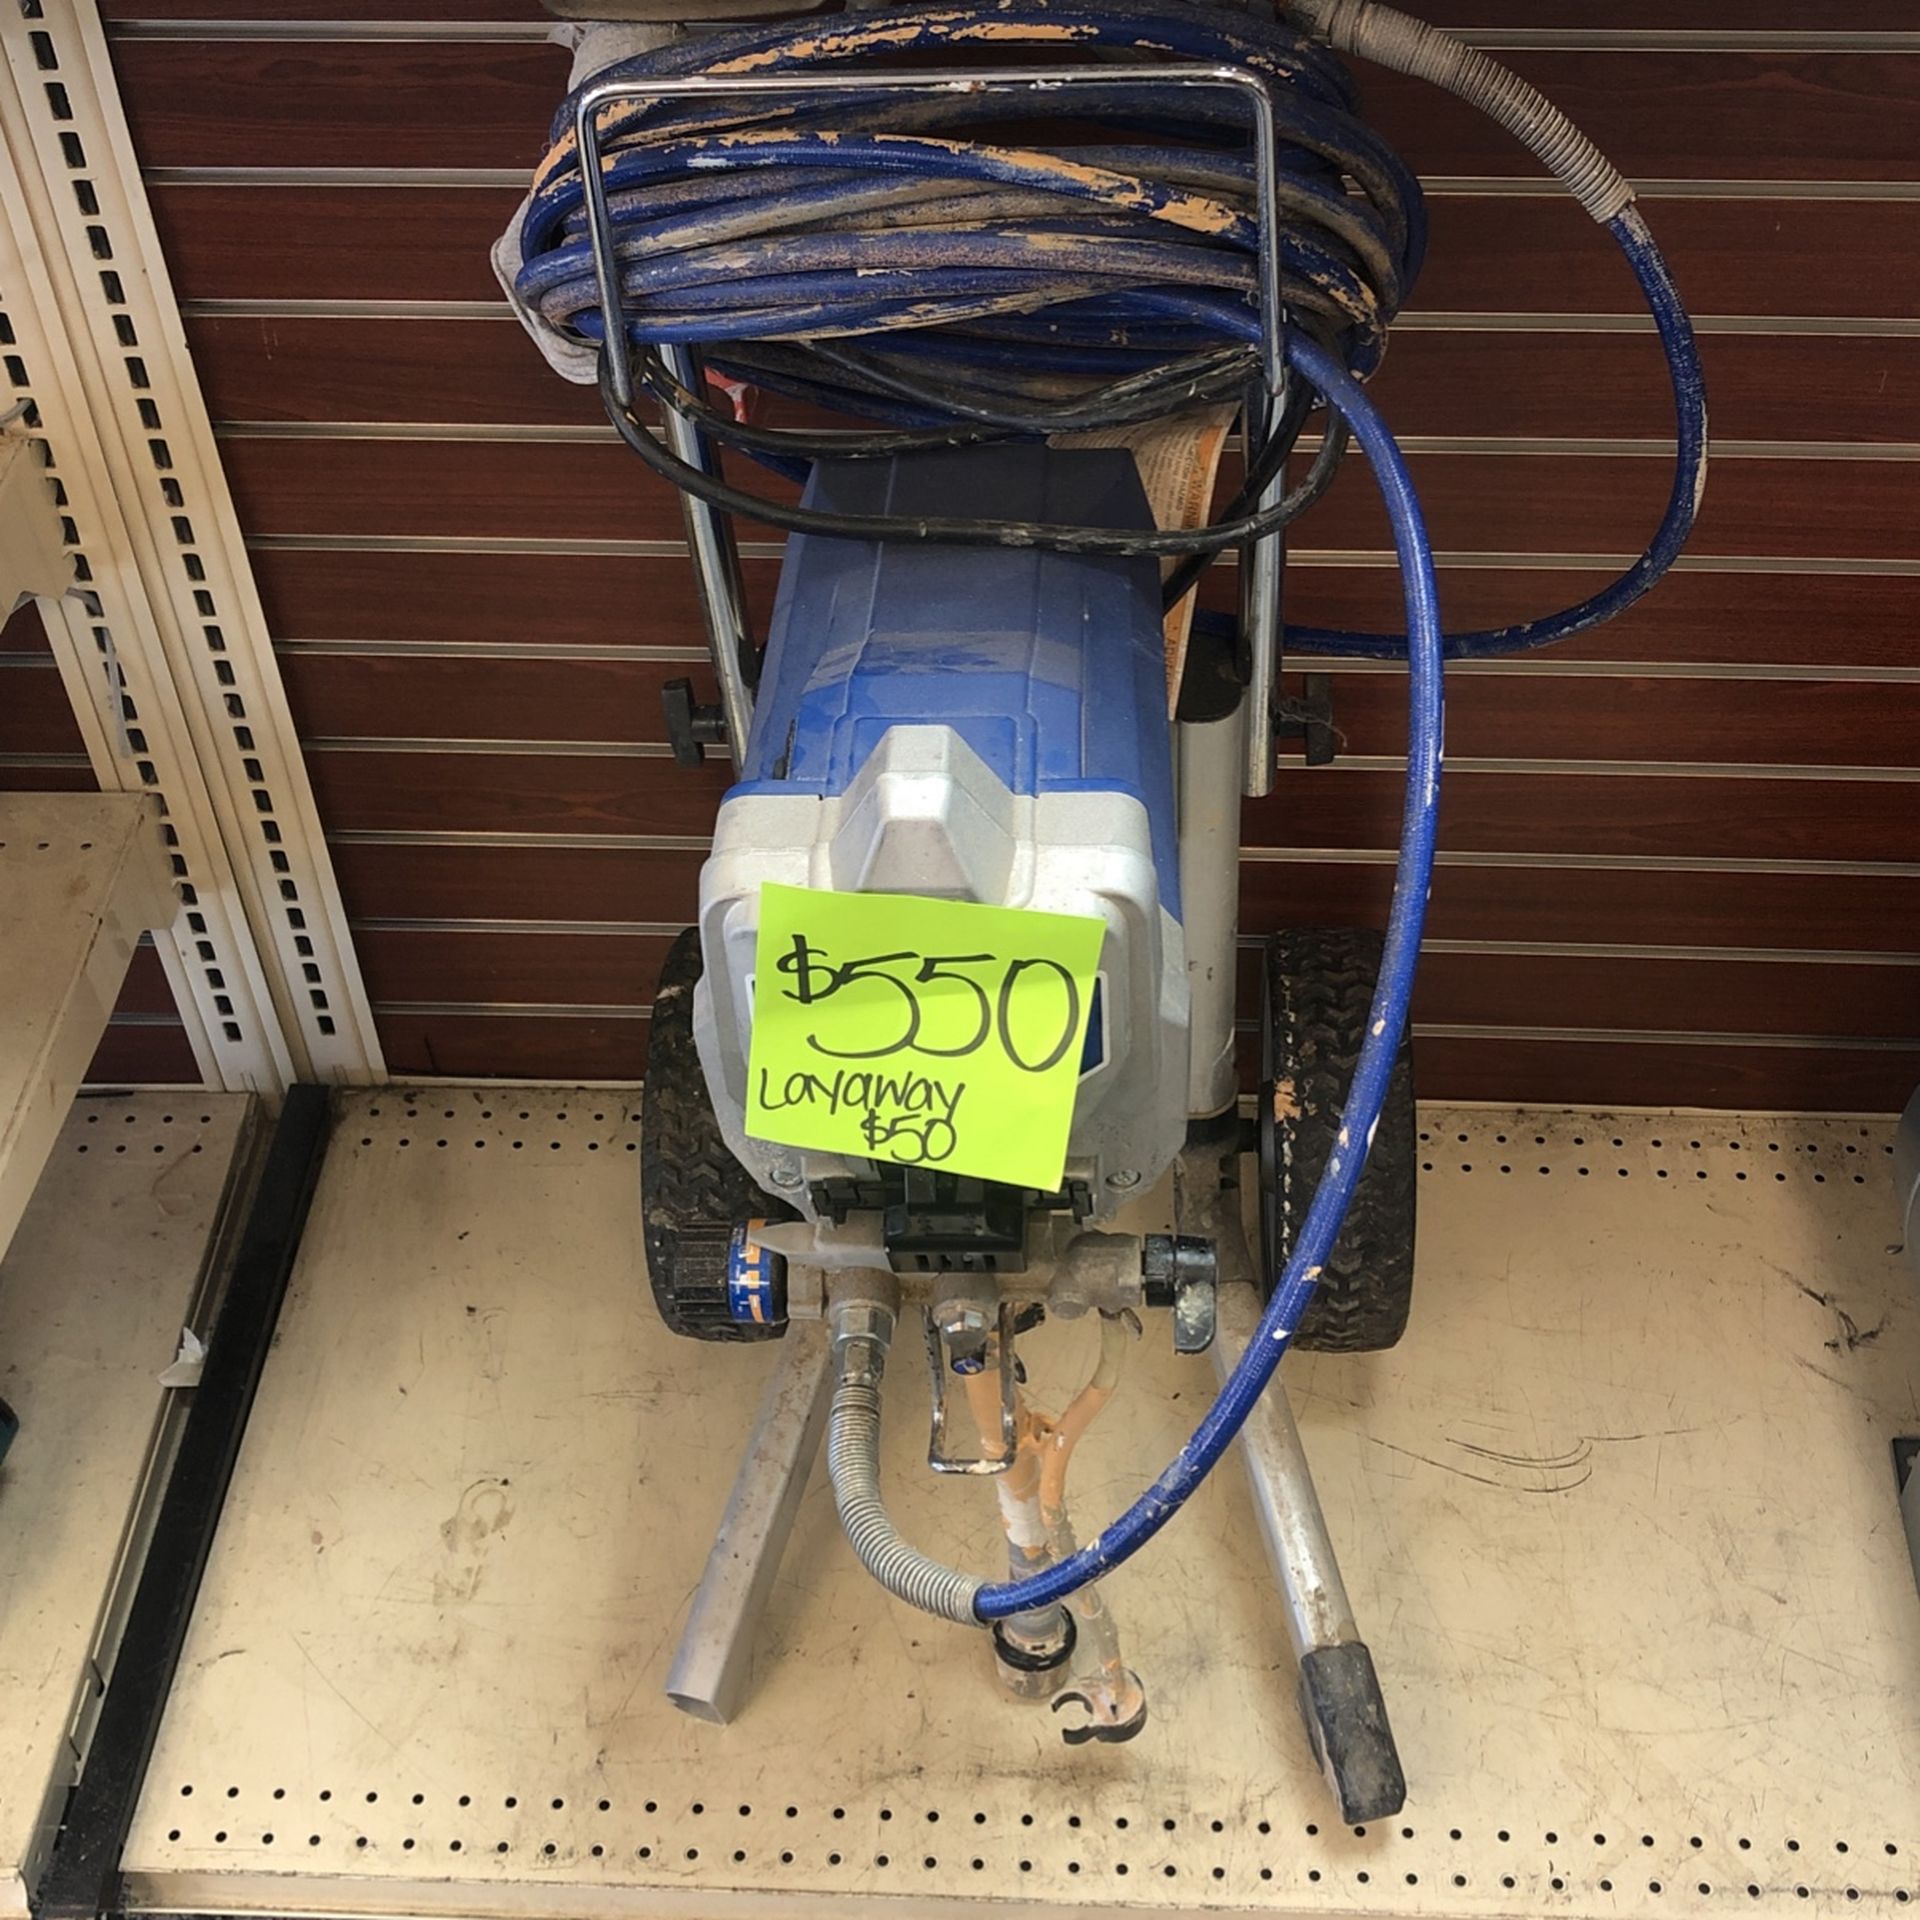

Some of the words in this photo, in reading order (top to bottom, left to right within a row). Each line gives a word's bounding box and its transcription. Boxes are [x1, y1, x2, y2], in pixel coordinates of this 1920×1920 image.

[1182, 480, 1204, 530] WARNIN
[776, 934, 1080, 1073] $550
[759, 1067, 966, 1124] Layaway
[859, 1108, 958, 1163] $50
